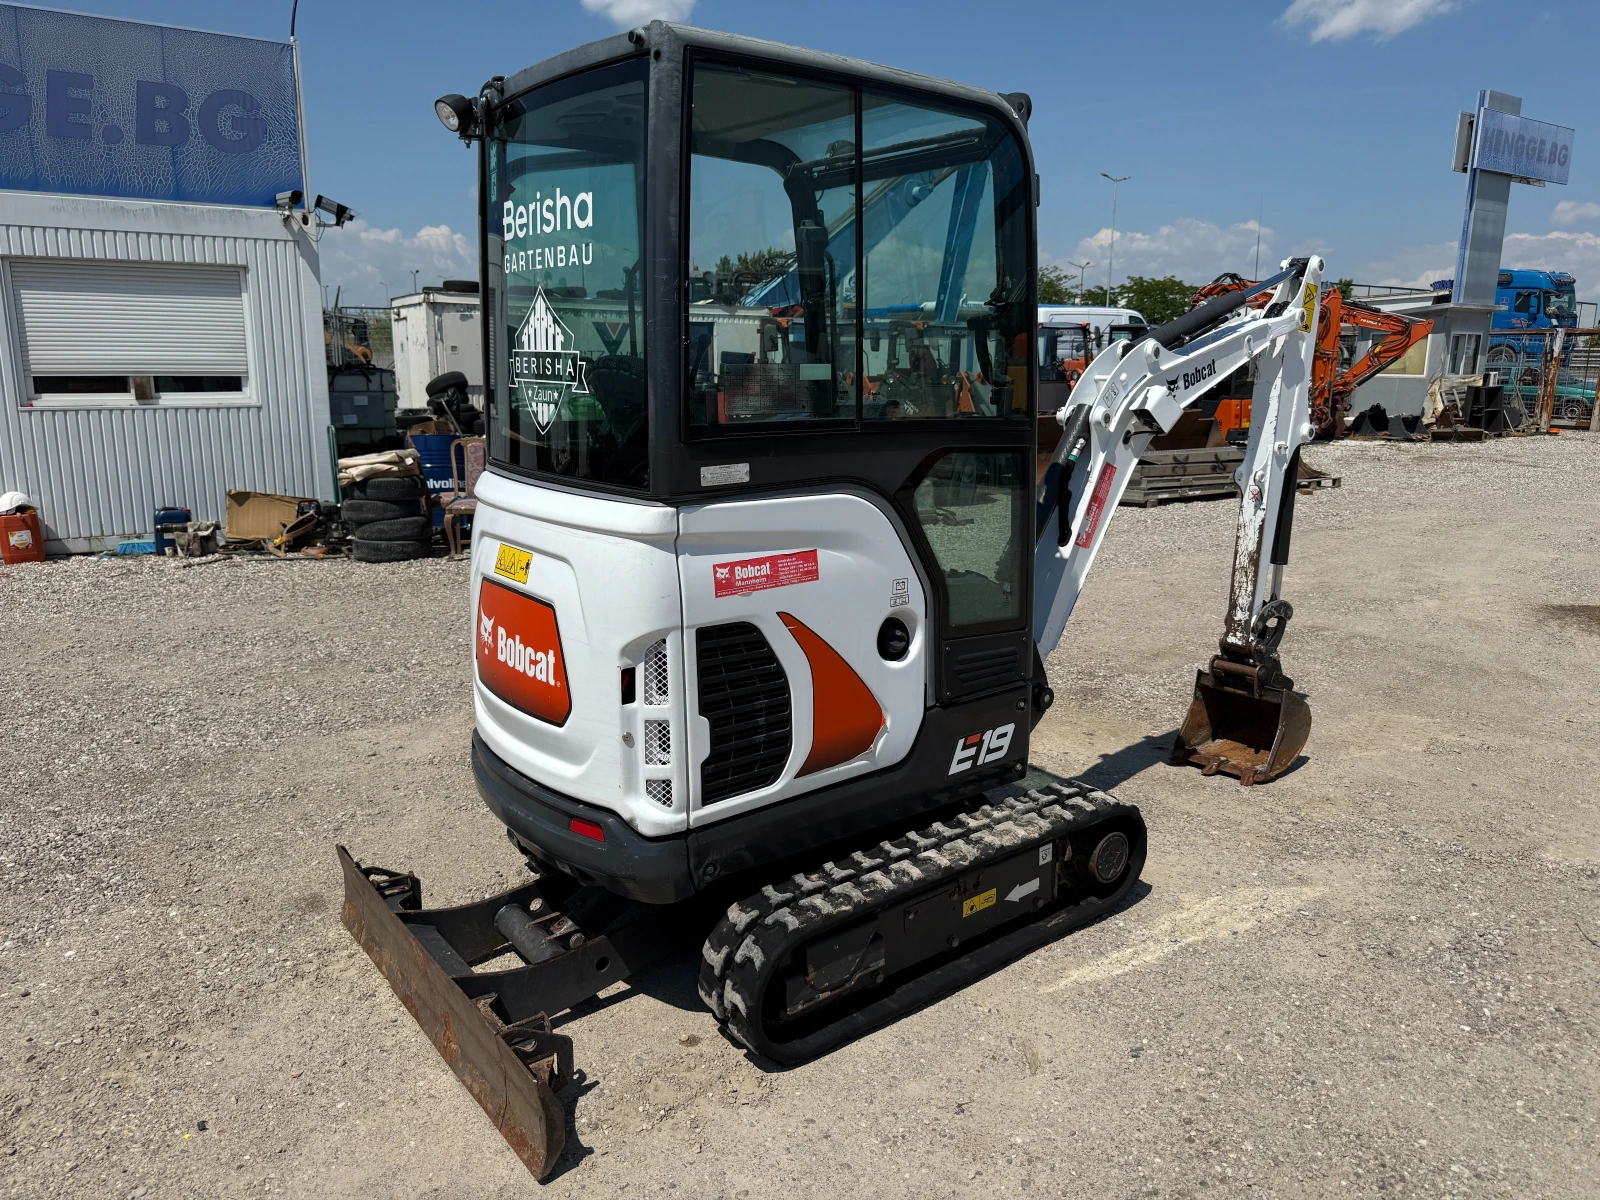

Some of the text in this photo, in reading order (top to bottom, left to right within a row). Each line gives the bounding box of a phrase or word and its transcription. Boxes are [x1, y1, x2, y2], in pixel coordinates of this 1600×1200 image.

[503, 187, 593, 241] Berisha
[504, 242, 593, 274] GARTENBAU
[515, 357, 575, 376] BERISHA
[1182, 358, 1217, 391] Bobcat
[533, 385, 553, 402] Zaun
[734, 562, 771, 580] Bobcat
[735, 576, 767, 587] Mannheim
[497, 625, 556, 687] Bobcat
[947, 722, 1016, 776] E19
